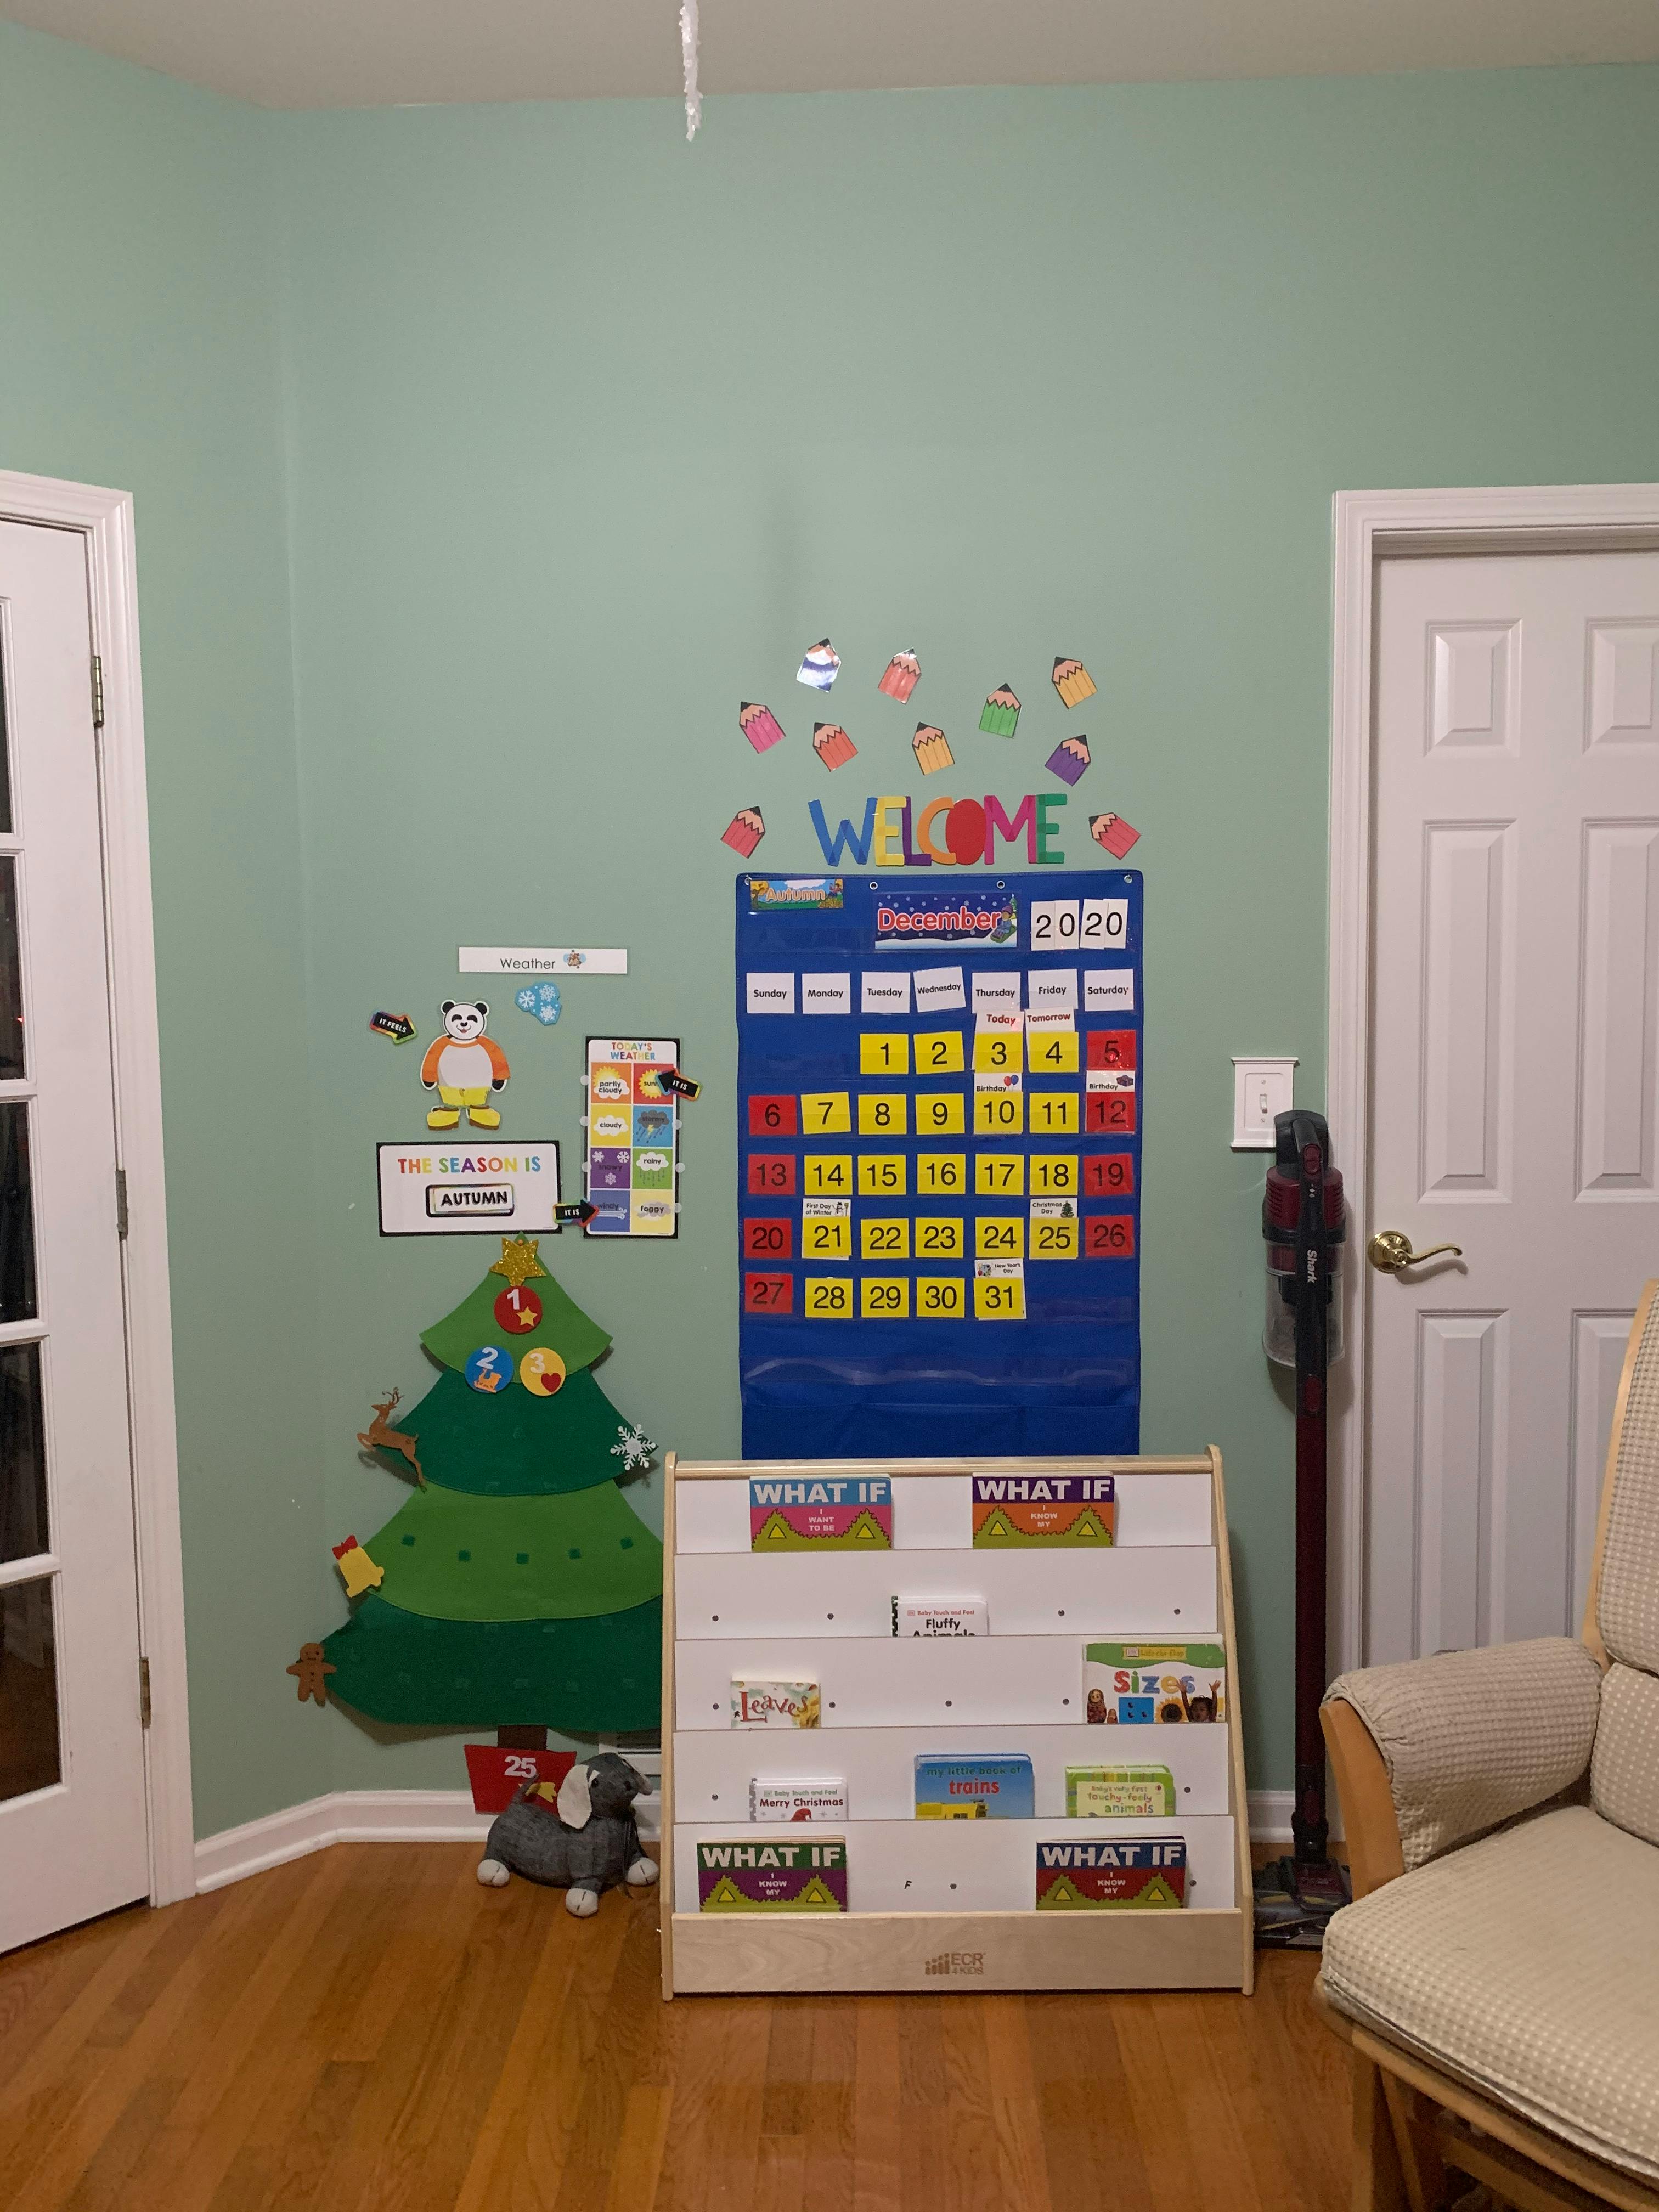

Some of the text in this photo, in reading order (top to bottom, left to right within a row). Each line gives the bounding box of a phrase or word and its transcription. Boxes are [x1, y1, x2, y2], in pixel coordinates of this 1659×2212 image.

[808, 794, 1068, 866] WELCOME
[766, 888, 826, 901] Autumn
[878, 906, 1001, 931] December
[500, 958, 556, 969] Weather
[754, 983, 1128, 1000] Sunday Monday Tuesday Wednesday Thursday Friday Saturday
[387, 1021, 407, 1033] FEELS
[987, 1013, 1070, 1026] Today Tomorrow
[611, 1042, 652, 1051] TODAY'S
[880, 1040, 1120, 1065] 1 2 3 4 5
[610, 1052, 656, 1060] WEATHER
[600, 1081, 621, 1090] partly
[765, 1100, 1126, 1127] 6 7 8 9 10 11 12
[397, 1156, 541, 1174] THE SEASON IS
[756, 1163, 1124, 1187] 13 14 15 16 17 18 19
[441, 1191, 508, 1207] AUTUMN
[598, 1203, 619, 1211] windy
[640, 1205, 664, 1214] foggy
[752, 1224, 1125, 1250] 20 21 22 23 24 25 26
[1307, 1250, 1317, 1283] Shark
[507, 1289, 520, 1310] 1
[752, 1281, 1012, 1310] 27 28 29 30 31
[476, 1347, 545, 1374] 2 3
[754, 1482, 887, 1504] WHAT IF
[977, 1480, 1111, 1500] WHAT IF
[926, 1618, 961, 1631] Fluffy
[1114, 1671, 1196, 1694] Sizes
[739, 1691, 808, 1723] Leaves
[504, 1756, 537, 1778] 25
[926, 1765, 1022, 1778] my little book of
[949, 1778, 1000, 1795] trains
[760, 1797, 843, 1809] Merry Christmas
[1087, 1792, 1152, 1803] touchy-feely
[1105, 1803, 1154, 1813] animals
[702, 1847, 840, 1867] WHAT IF
[1042, 1846, 1182, 1866] WHAT IF
[904, 1880, 912, 1889] F
[951, 1953, 983, 1966] ECR
